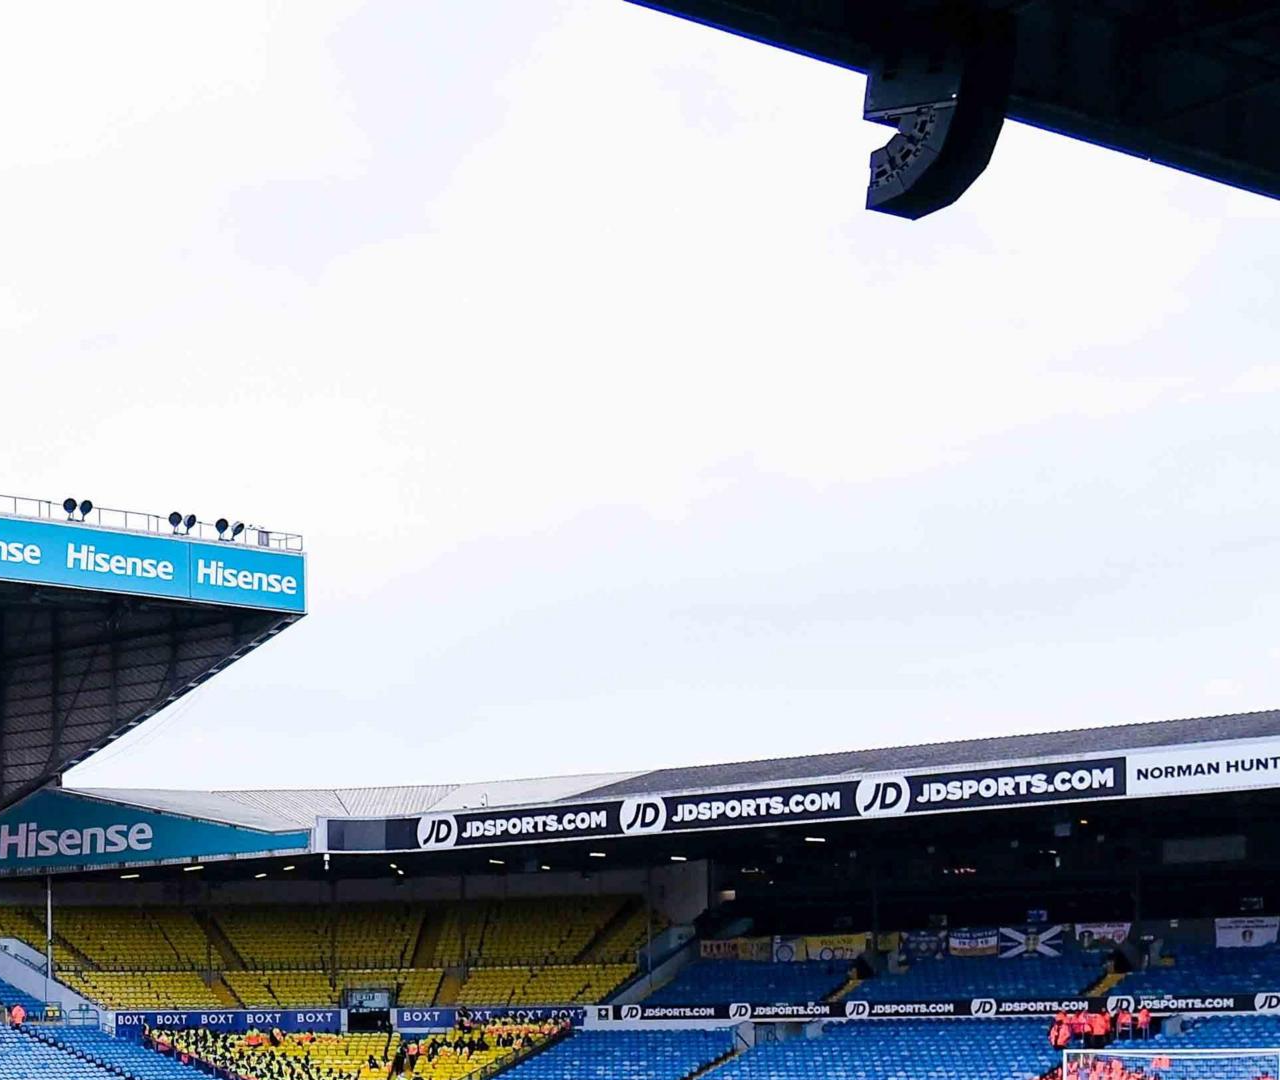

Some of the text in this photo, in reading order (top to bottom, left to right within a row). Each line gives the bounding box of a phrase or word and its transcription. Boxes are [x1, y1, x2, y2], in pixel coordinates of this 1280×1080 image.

[67, 544, 174, 581] Hisense
[197, 560, 297, 594] Hisense
[1136, 760, 1221, 781] NORMAN
[916, 767, 1114, 803] JDSPORTS.COM
[671, 791, 840, 824] JDSPORTS.COM
[460, 811, 607, 840] JDSPORTS.COM
[0, 823, 152, 859] Hisense
[871, 1003, 954, 1014] JDSPORTS.COM
[998, 1000, 1089, 1012] JDSPORTS.COM
[1137, 998, 1234, 1010] JDSPORTS.COM
[643, 1006, 715, 1017] JDSPORTS.COM
[752, 1005, 830, 1016] JDSPORTS.COM
[118, 1014, 145, 1025] BOXT
[157, 1014, 187, 1025] BOXT
[201, 1014, 234, 1025] BOXT
[247, 1014, 282, 1024] BOXT
[297, 1012, 333, 1023] BOXT
[403, 1012, 440, 1022] BOXT
